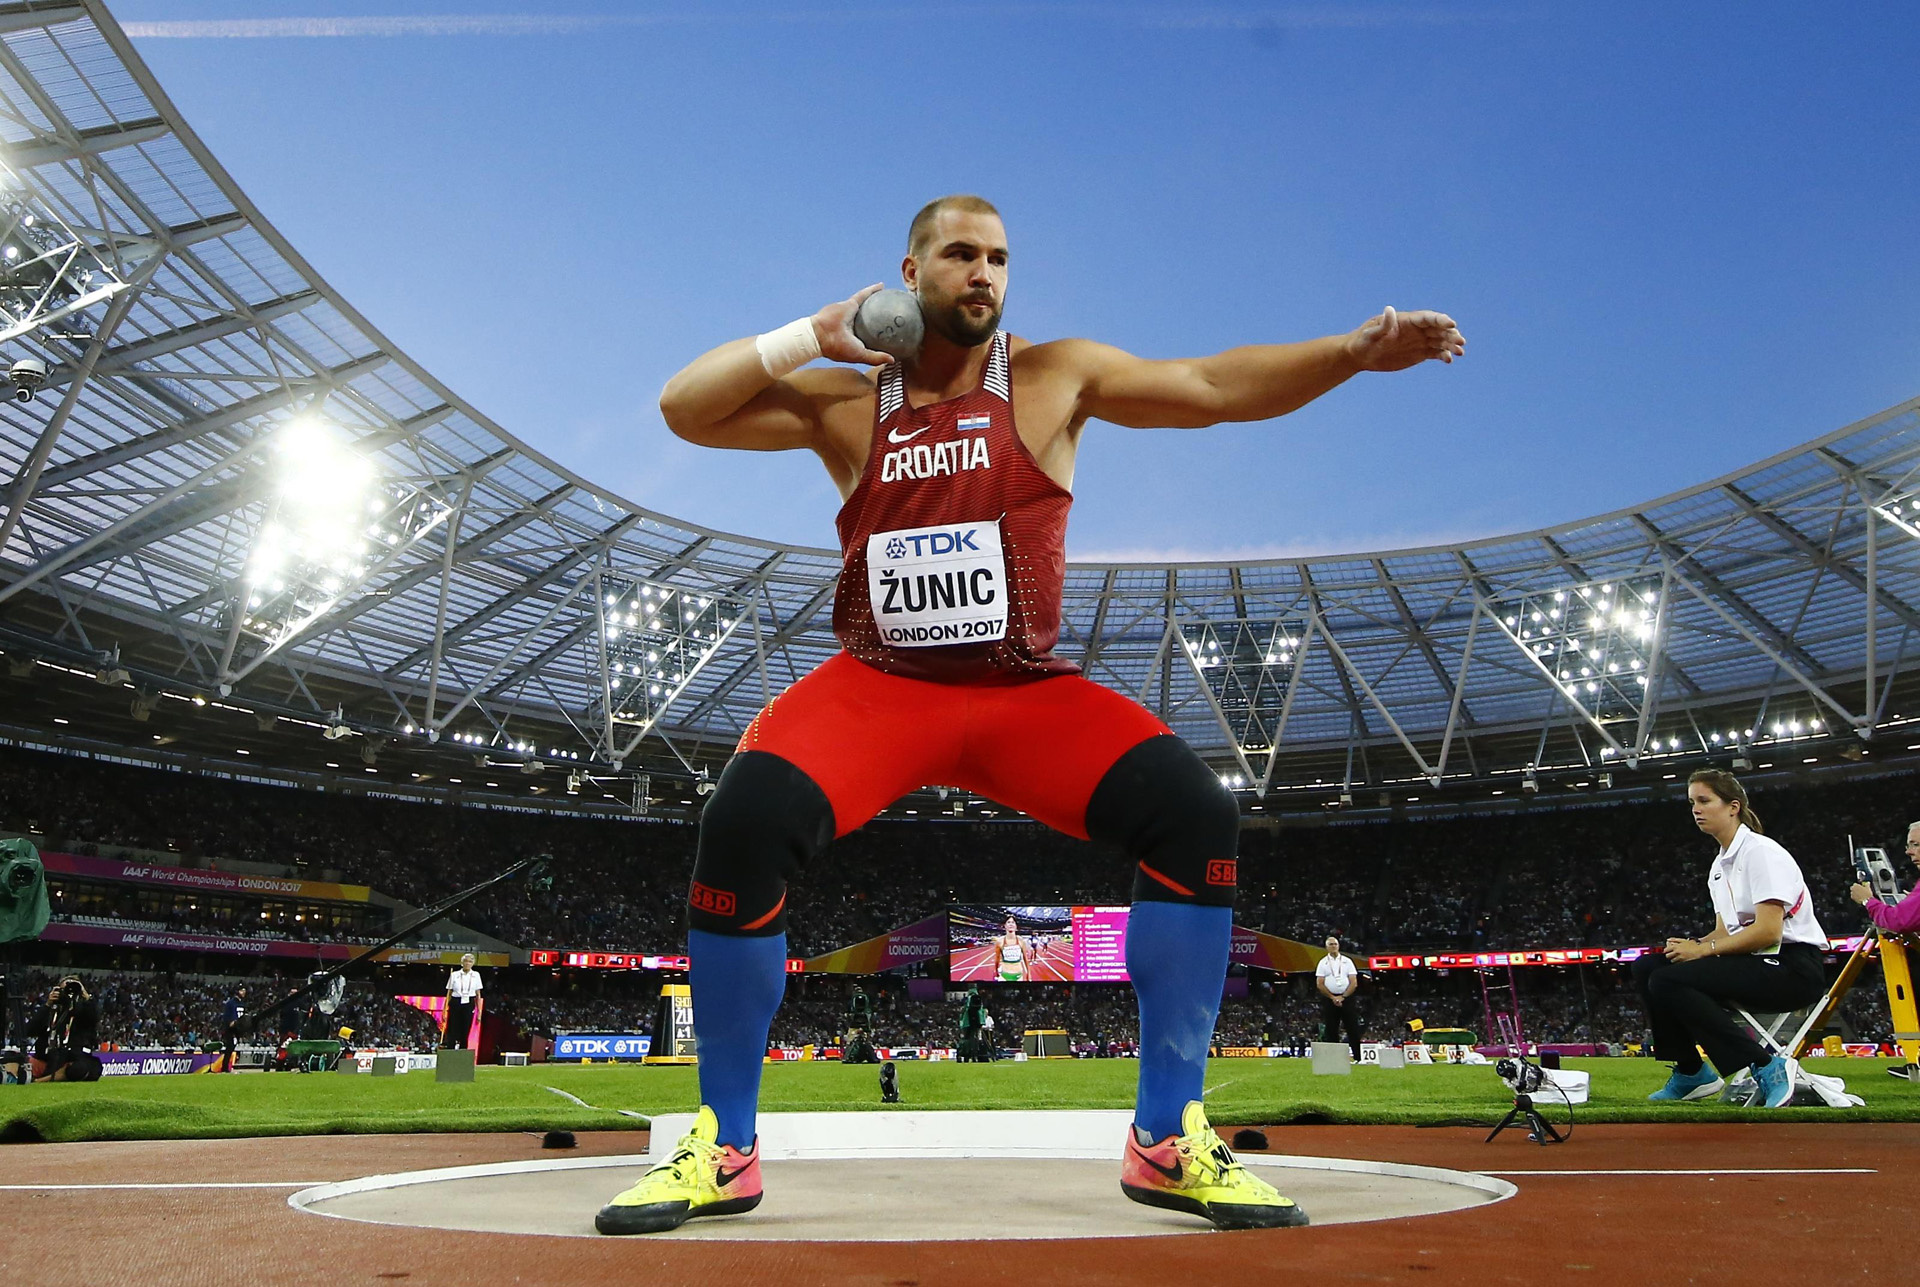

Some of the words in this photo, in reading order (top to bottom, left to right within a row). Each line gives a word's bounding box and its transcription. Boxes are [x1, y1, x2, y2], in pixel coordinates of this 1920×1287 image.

[881, 437, 990, 483] CROATIA
[905, 529, 980, 557] TDK
[880, 568, 995, 614] ŽUNIC
[882, 624, 958, 642] LONDON
[962, 619, 1004, 637] 2017
[122, 866, 149, 878] IAAF
[151, 869, 175, 881] World
[177, 872, 236, 889] Championships
[238, 877, 279, 891] LONDON
[280, 882, 302, 892] 2017
[692, 887, 731, 911] SBD
[122, 934, 144, 943] IAAF
[145, 935, 166, 945] World
[166, 937, 214, 949] Championships
[216, 940, 249, 950] LONDON
[250, 943, 268, 952] 2017
[888, 945, 922, 956] LONDON
[923, 945, 940, 956] 2017
[1234, 943, 1257, 953] 2017
[572, 1040, 610, 1053] TDK
[626, 1040, 651, 1053] TD
[1363, 1050, 1376, 1060] 20
[1407, 1050, 1420, 1060] CR
[101, 1058, 140, 1076] pionships
[142, 1058, 175, 1074] LONDON
[175, 1058, 192, 1074] 2017
[357, 1058, 372, 1068] CR
[395, 1058, 406, 1069] 0
[1210, 1143, 1237, 1166] NI
